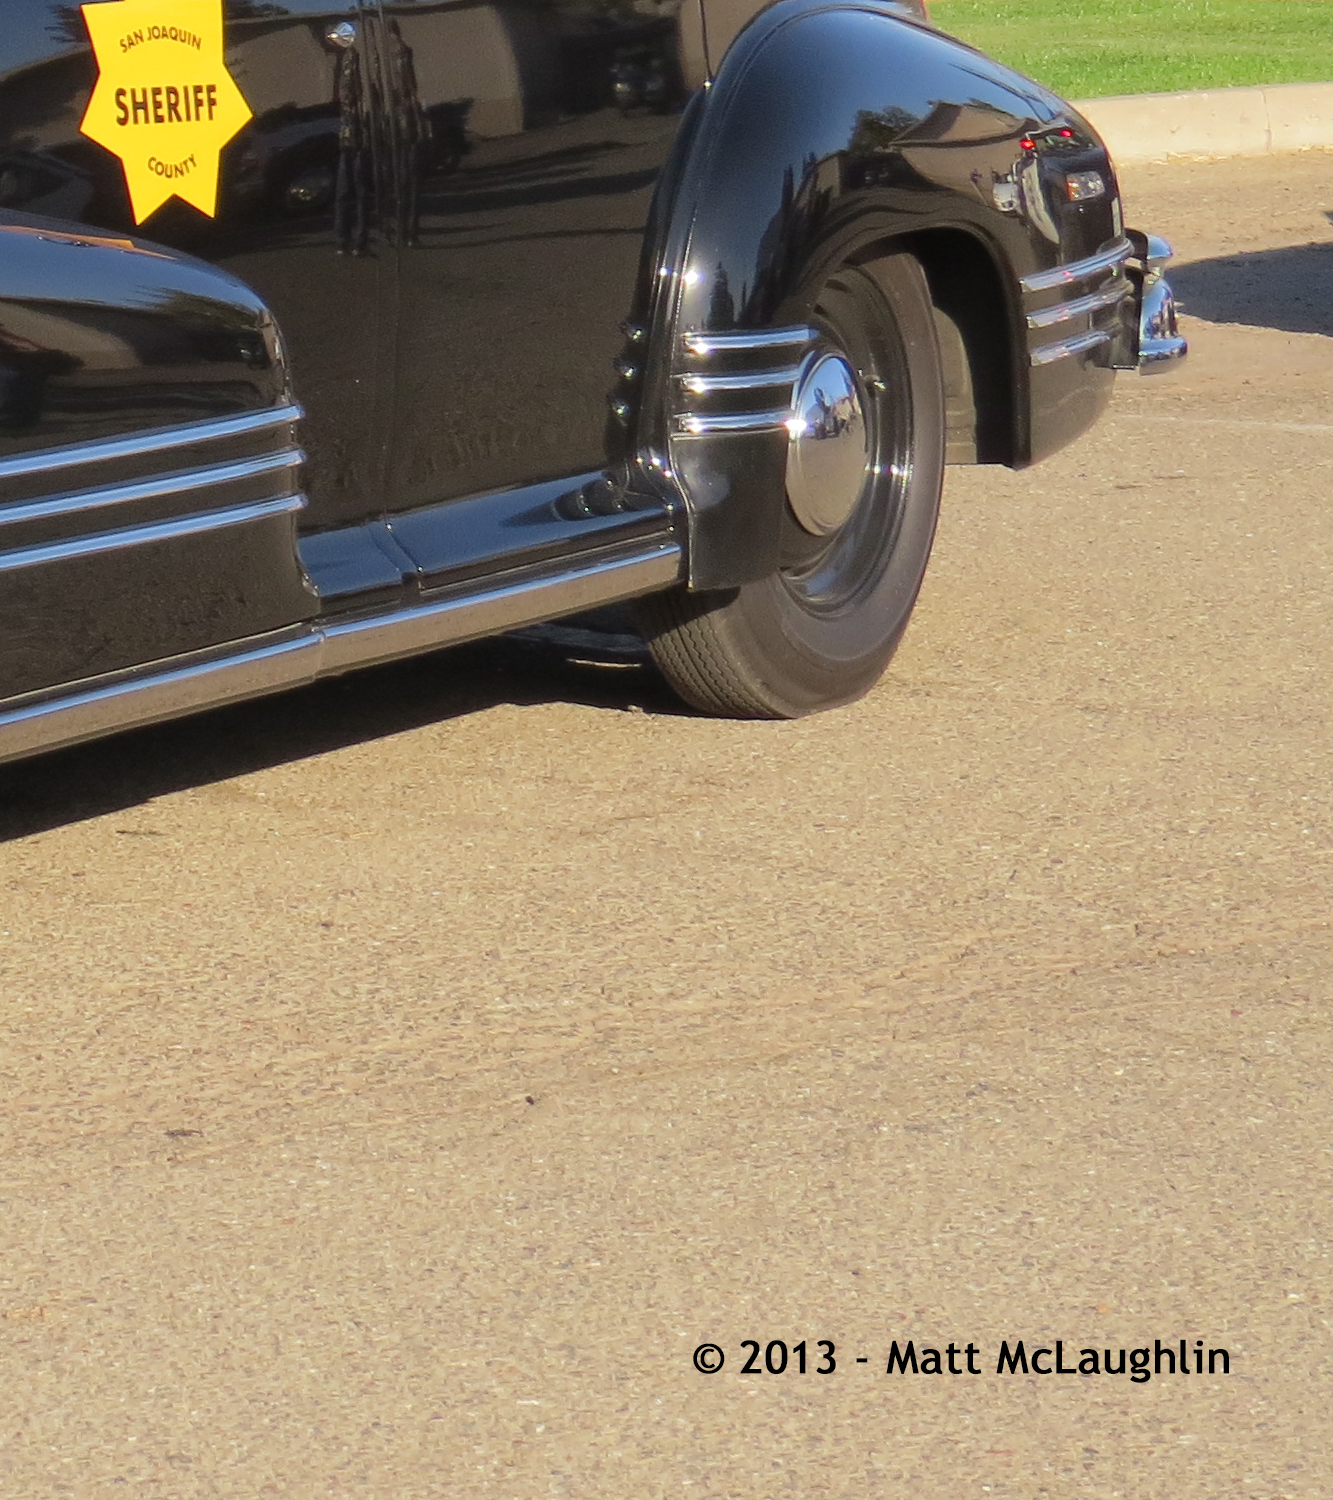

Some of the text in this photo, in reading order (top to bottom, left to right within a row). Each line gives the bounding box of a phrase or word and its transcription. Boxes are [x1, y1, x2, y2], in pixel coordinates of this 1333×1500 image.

[119, 24, 202, 54] SAN JOAQUIN
[114, 84, 218, 127] SHERIFF
[147, 153, 199, 179] COUNTY
